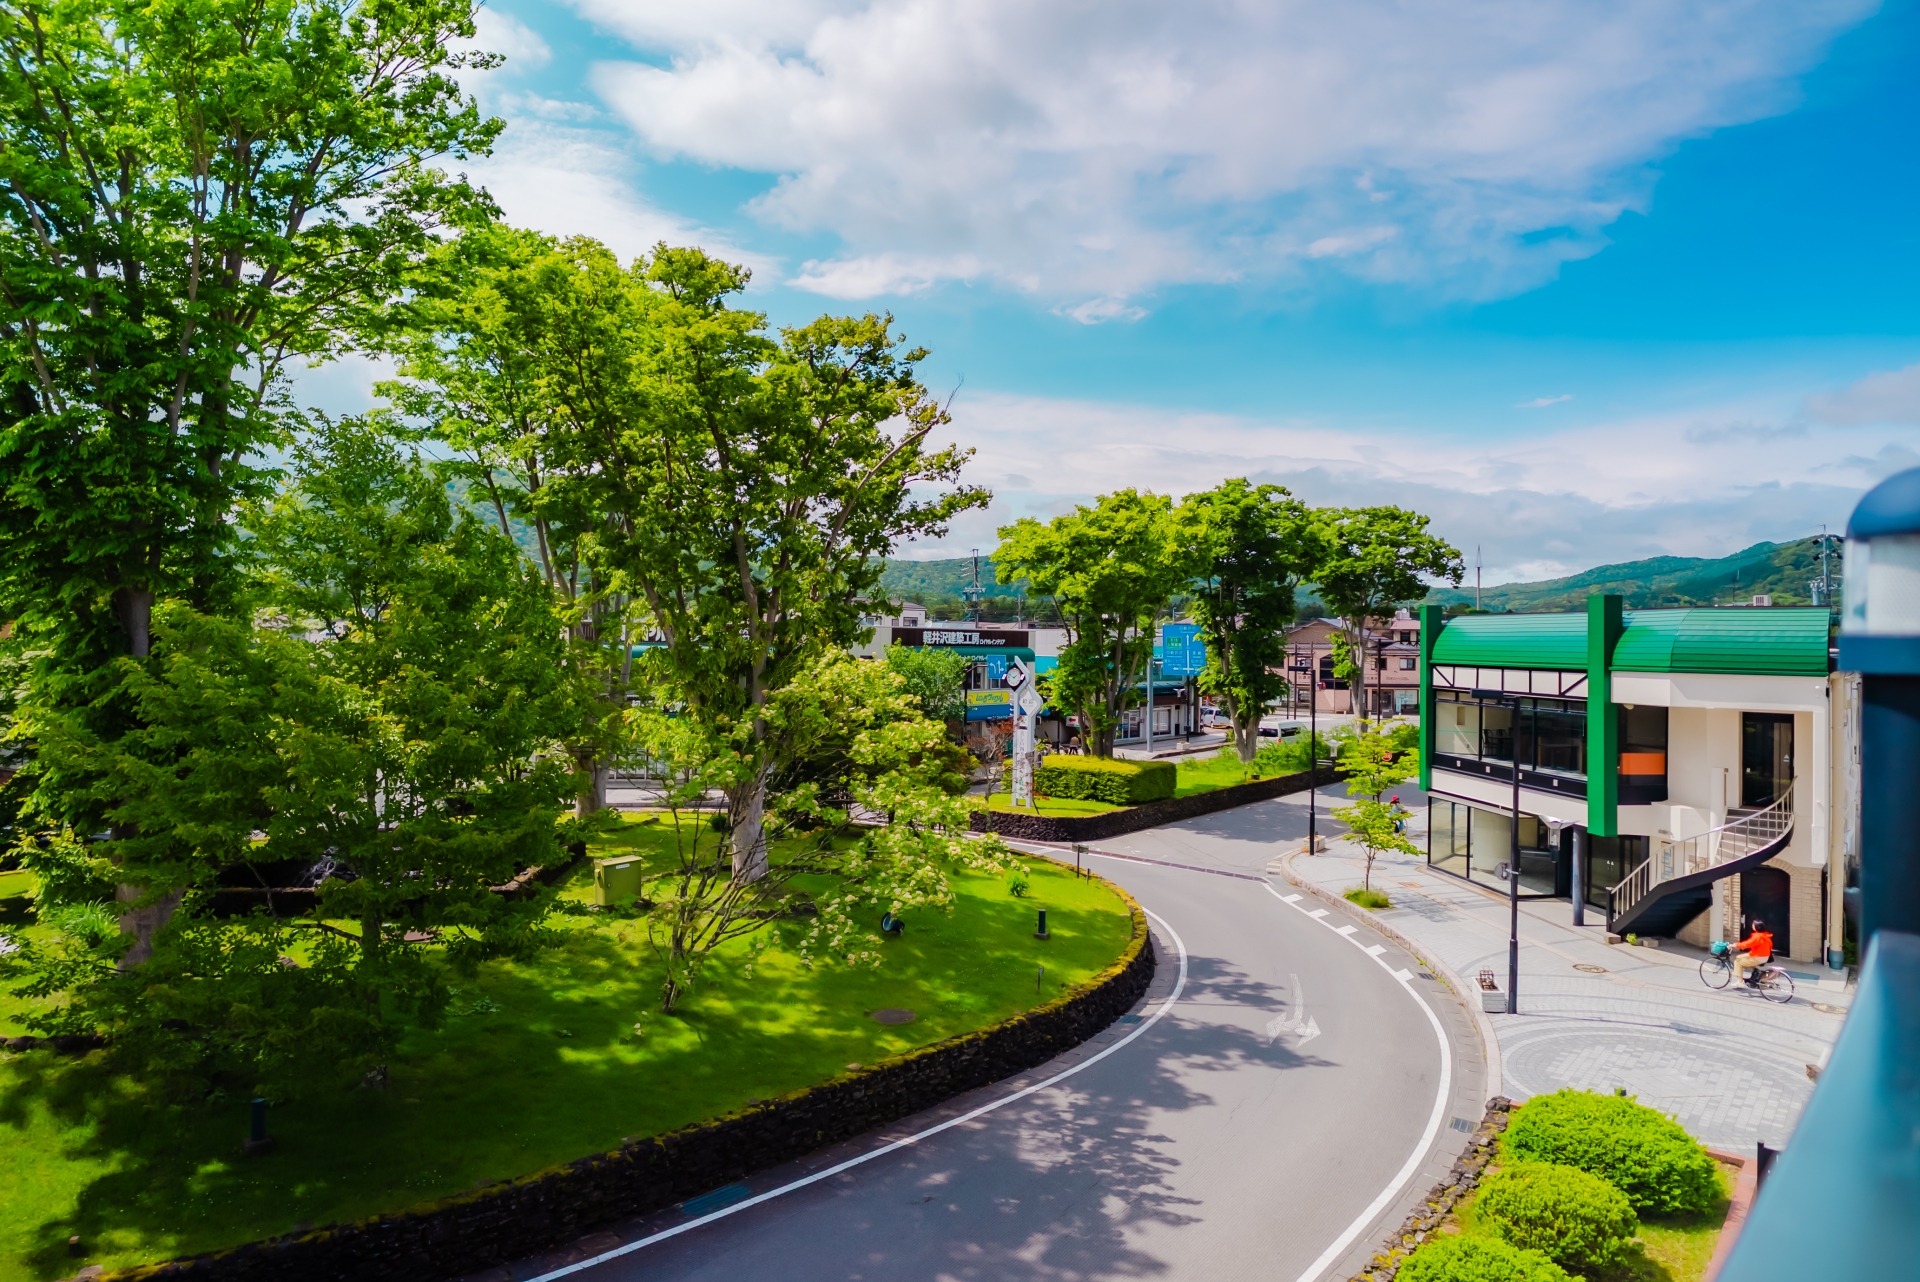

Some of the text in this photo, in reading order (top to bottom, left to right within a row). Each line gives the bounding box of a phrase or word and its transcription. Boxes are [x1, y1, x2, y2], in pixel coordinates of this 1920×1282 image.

[923, 631, 980, 645] 軽井沢建築工房
